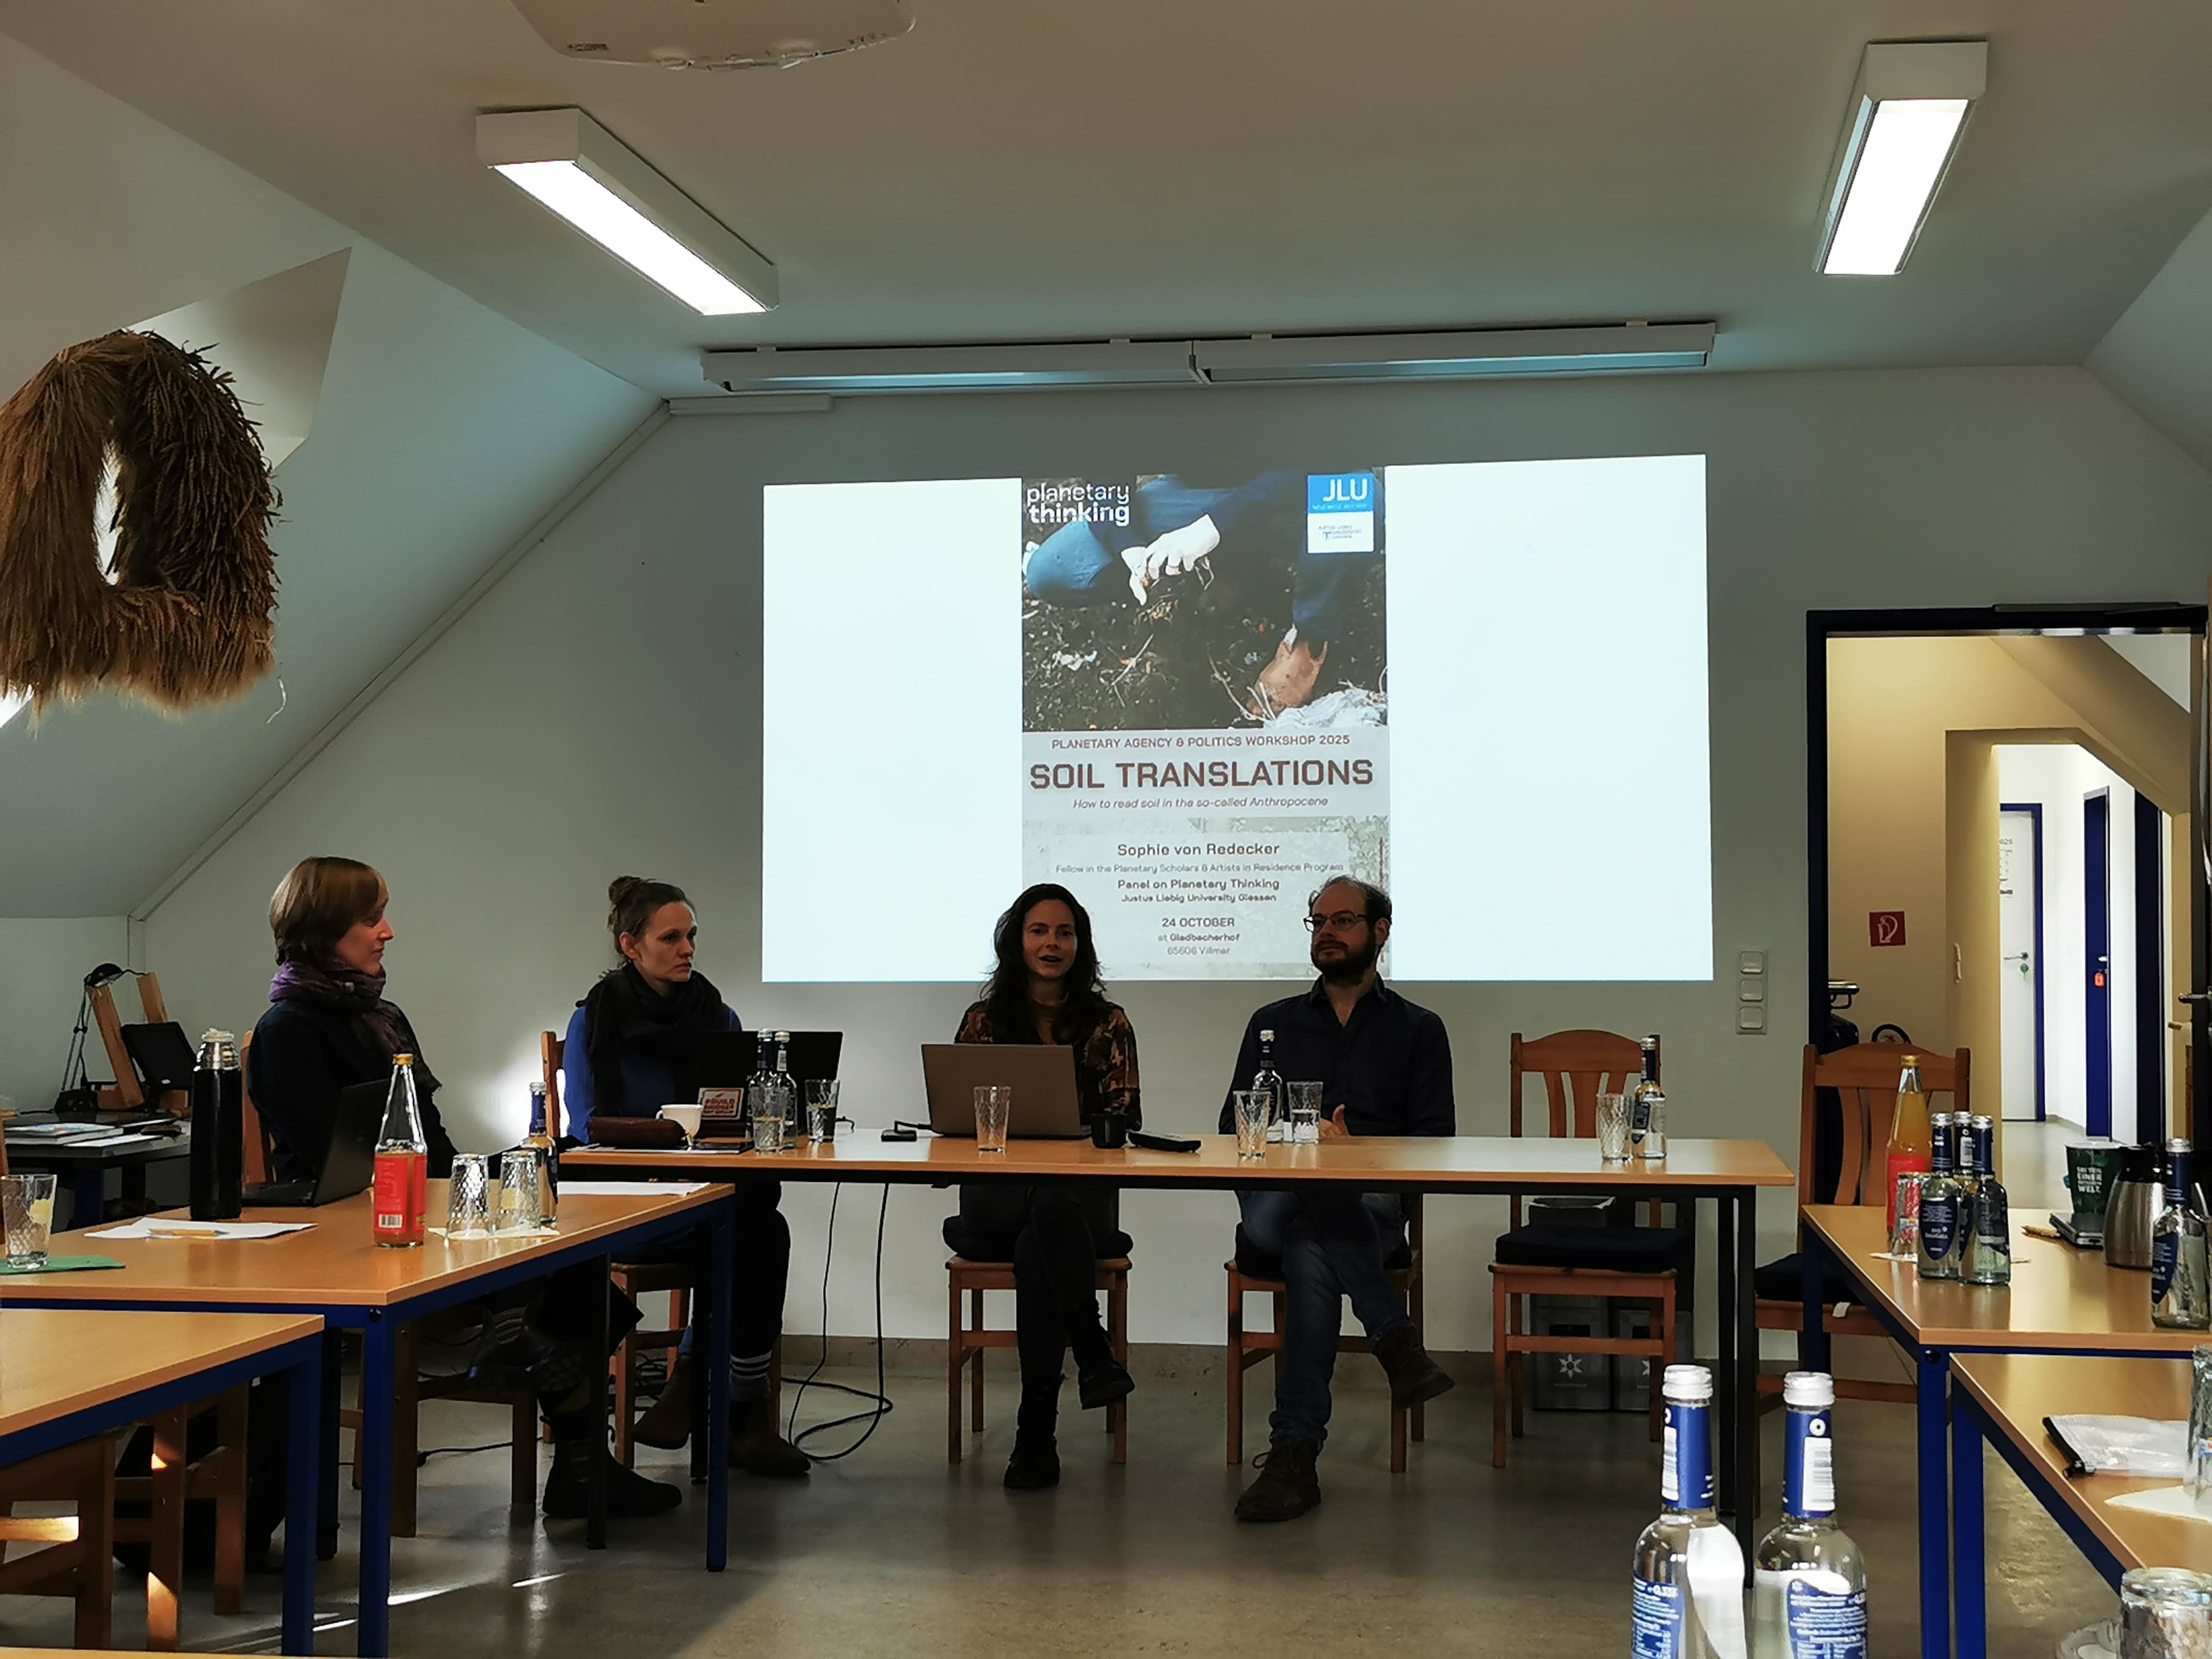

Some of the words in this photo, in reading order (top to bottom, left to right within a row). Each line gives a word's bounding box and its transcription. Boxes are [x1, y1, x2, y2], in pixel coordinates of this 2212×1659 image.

[1027, 483, 1129, 507] planetary
[1322, 478, 1367, 501] JLU
[1029, 501, 1130, 526] thinking
[1052, 739, 1120, 749] PLANETARY
[1124, 738, 1172, 748] AGENCY
[1188, 737, 1242, 747] POLITICS
[1246, 736, 1315, 746] WORKSHOP
[1319, 734, 1350, 745] 2025
[1031, 763, 1105, 789] SOIL
[1115, 759, 1373, 788] TRANSLATIONS
[1073, 799, 1096, 808] How
[1100, 799, 1110, 808] to
[1113, 798, 1138, 808] read
[1141, 797, 1160, 808] soil
[1162, 798, 1172, 808] in
[1176, 797, 1193, 808] the
[1196, 796, 1247, 807] so-called
[1250, 796, 1328, 808] Anthropocene
[1118, 843, 1169, 858] Sophie
[1175, 846, 1201, 855] von
[1207, 843, 1280, 855] Redecker
[1114, 864, 1158, 874] Planetary
[1160, 863, 1199, 872] Scholars
[1210, 863, 1240, 871] Artists
[1243, 863, 1251, 871] in
[1253, 862, 1301, 871] Residence
[1304, 862, 1344, 873] Program
[1118, 879, 1149, 889] Panel
[1171, 879, 1226, 891] Planetary
[1230, 879, 1279, 890] Thinking
[1156, 894, 1184, 903] Liebig
[1187, 894, 1235, 903] University
[1238, 893, 1276, 902] Giessen
[1162, 918, 1176, 927] 24
[1180, 917, 1235, 927] OCTOBER
[1170, 933, 1239, 942] Gladbacherhof
[1199, 947, 1230, 955] Villmar
